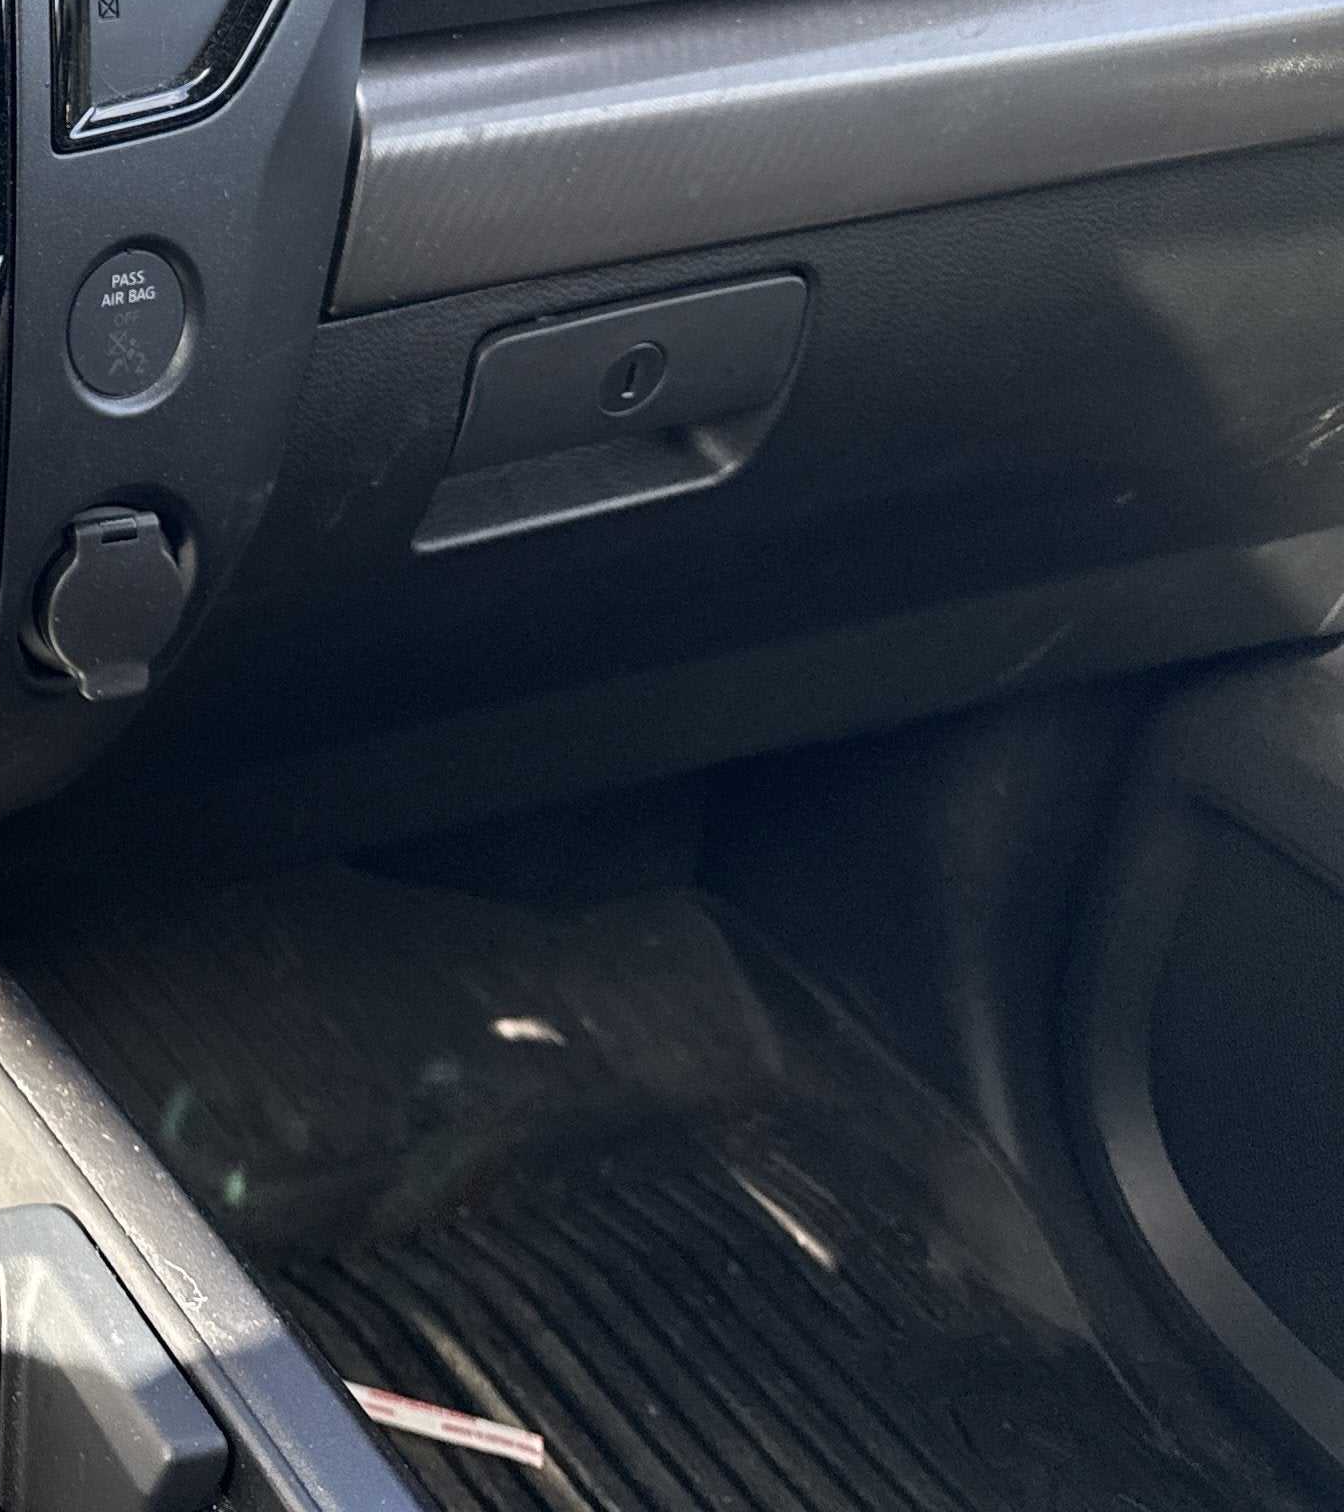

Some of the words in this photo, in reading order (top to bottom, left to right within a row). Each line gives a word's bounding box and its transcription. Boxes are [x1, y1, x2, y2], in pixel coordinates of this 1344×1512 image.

[111, 270, 146, 288] PASS
[100, 291, 125, 308] AIR
[128, 285, 157, 304] BAG
